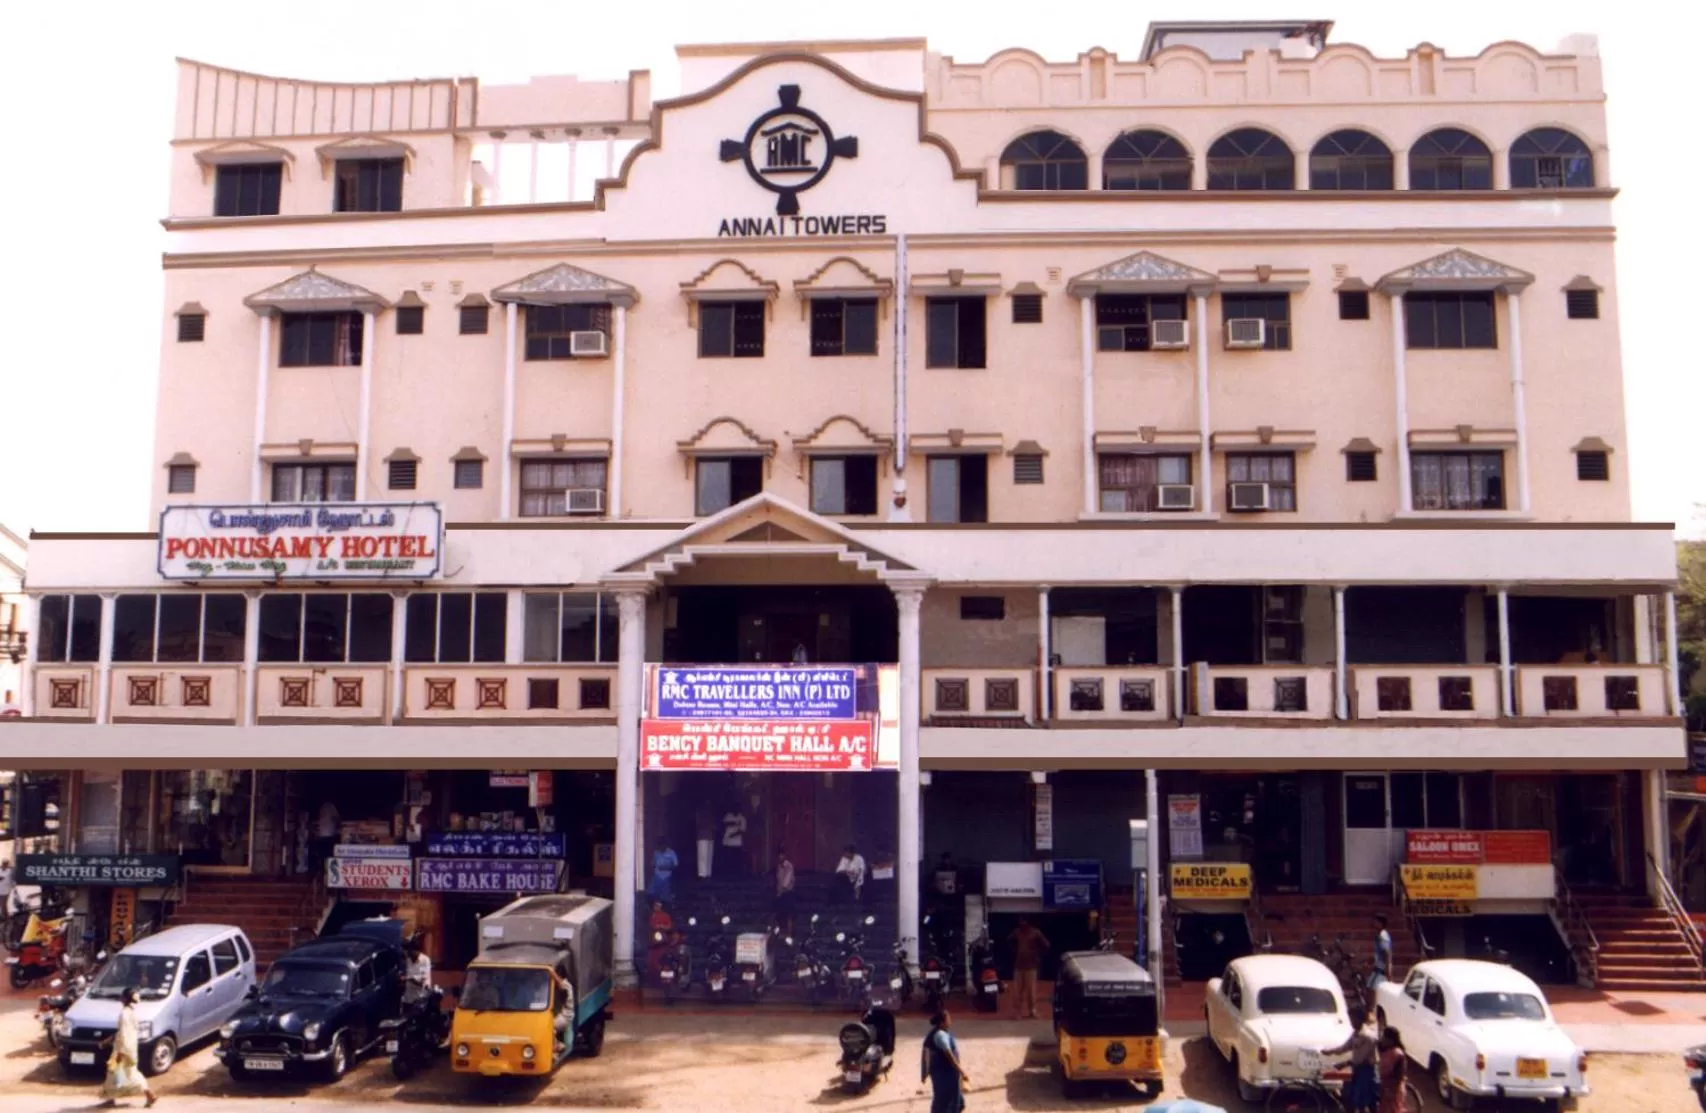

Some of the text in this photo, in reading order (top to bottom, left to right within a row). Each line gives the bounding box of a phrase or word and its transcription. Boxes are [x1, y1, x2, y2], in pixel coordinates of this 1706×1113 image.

[718, 215, 887, 237] ANNAI TOWERS
[166, 535, 435, 559] PONNUSAMY HOTEL
[662, 683, 850, 701] RMC TRAVELLERS INN (P) LTD
[647, 735, 867, 753] BENCY BANQUET HALL A/C
[26, 865, 167, 878] SHANTHI STORES
[342, 864, 410, 876] STUDENTS
[1191, 866, 1227, 876] DEEP
[344, 876, 389, 888] XEROX
[420, 872, 453, 889] RMC
[457, 873, 501, 889] BAKE
[1173, 877, 1248, 887] MEDICALS
